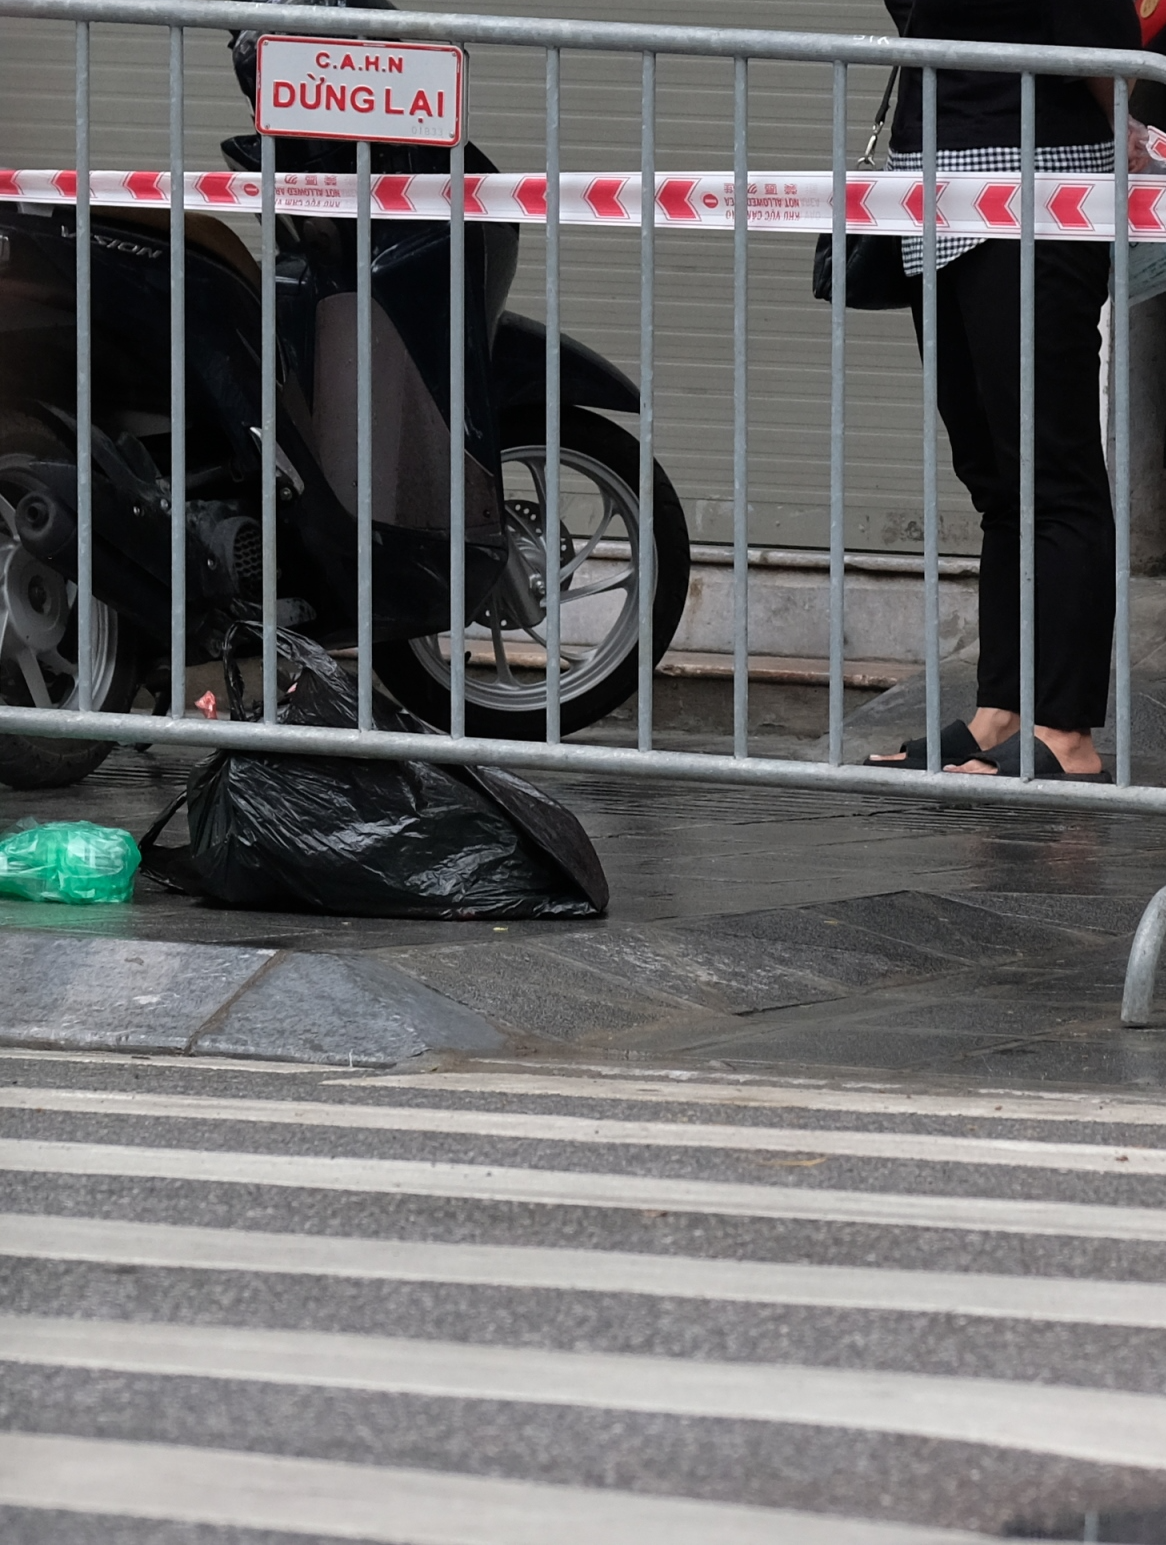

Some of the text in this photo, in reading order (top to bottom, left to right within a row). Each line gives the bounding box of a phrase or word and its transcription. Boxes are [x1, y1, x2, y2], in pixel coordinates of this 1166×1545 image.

[315, 51, 403, 73] C.A.H.N
[273, 72, 444, 123] DỪNG LẠI
[287, 187, 323, 197] ALLOWED
[785, 197, 800, 207] NOT
[61, 225, 163, 258] VSION
